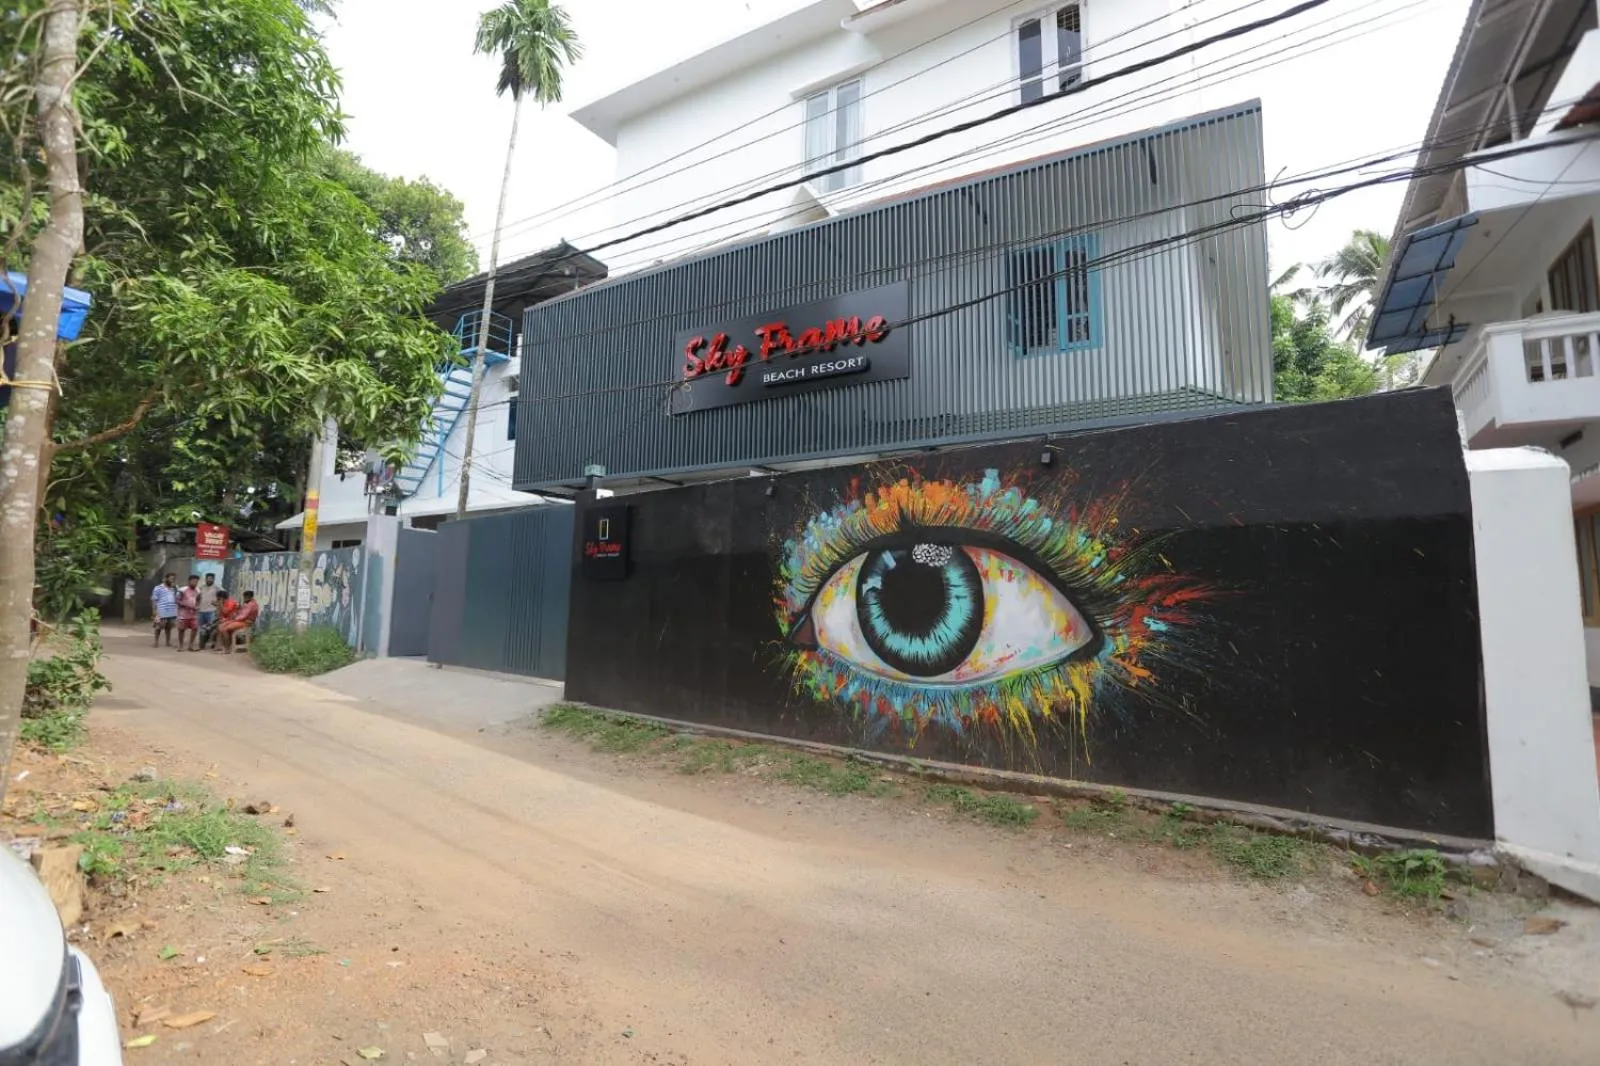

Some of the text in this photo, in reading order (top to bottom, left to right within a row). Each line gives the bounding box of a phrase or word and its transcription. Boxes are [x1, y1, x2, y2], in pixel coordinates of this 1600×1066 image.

[683, 315, 887, 385] Sky Frame
[763, 356, 864, 383] BEACH RESORT
